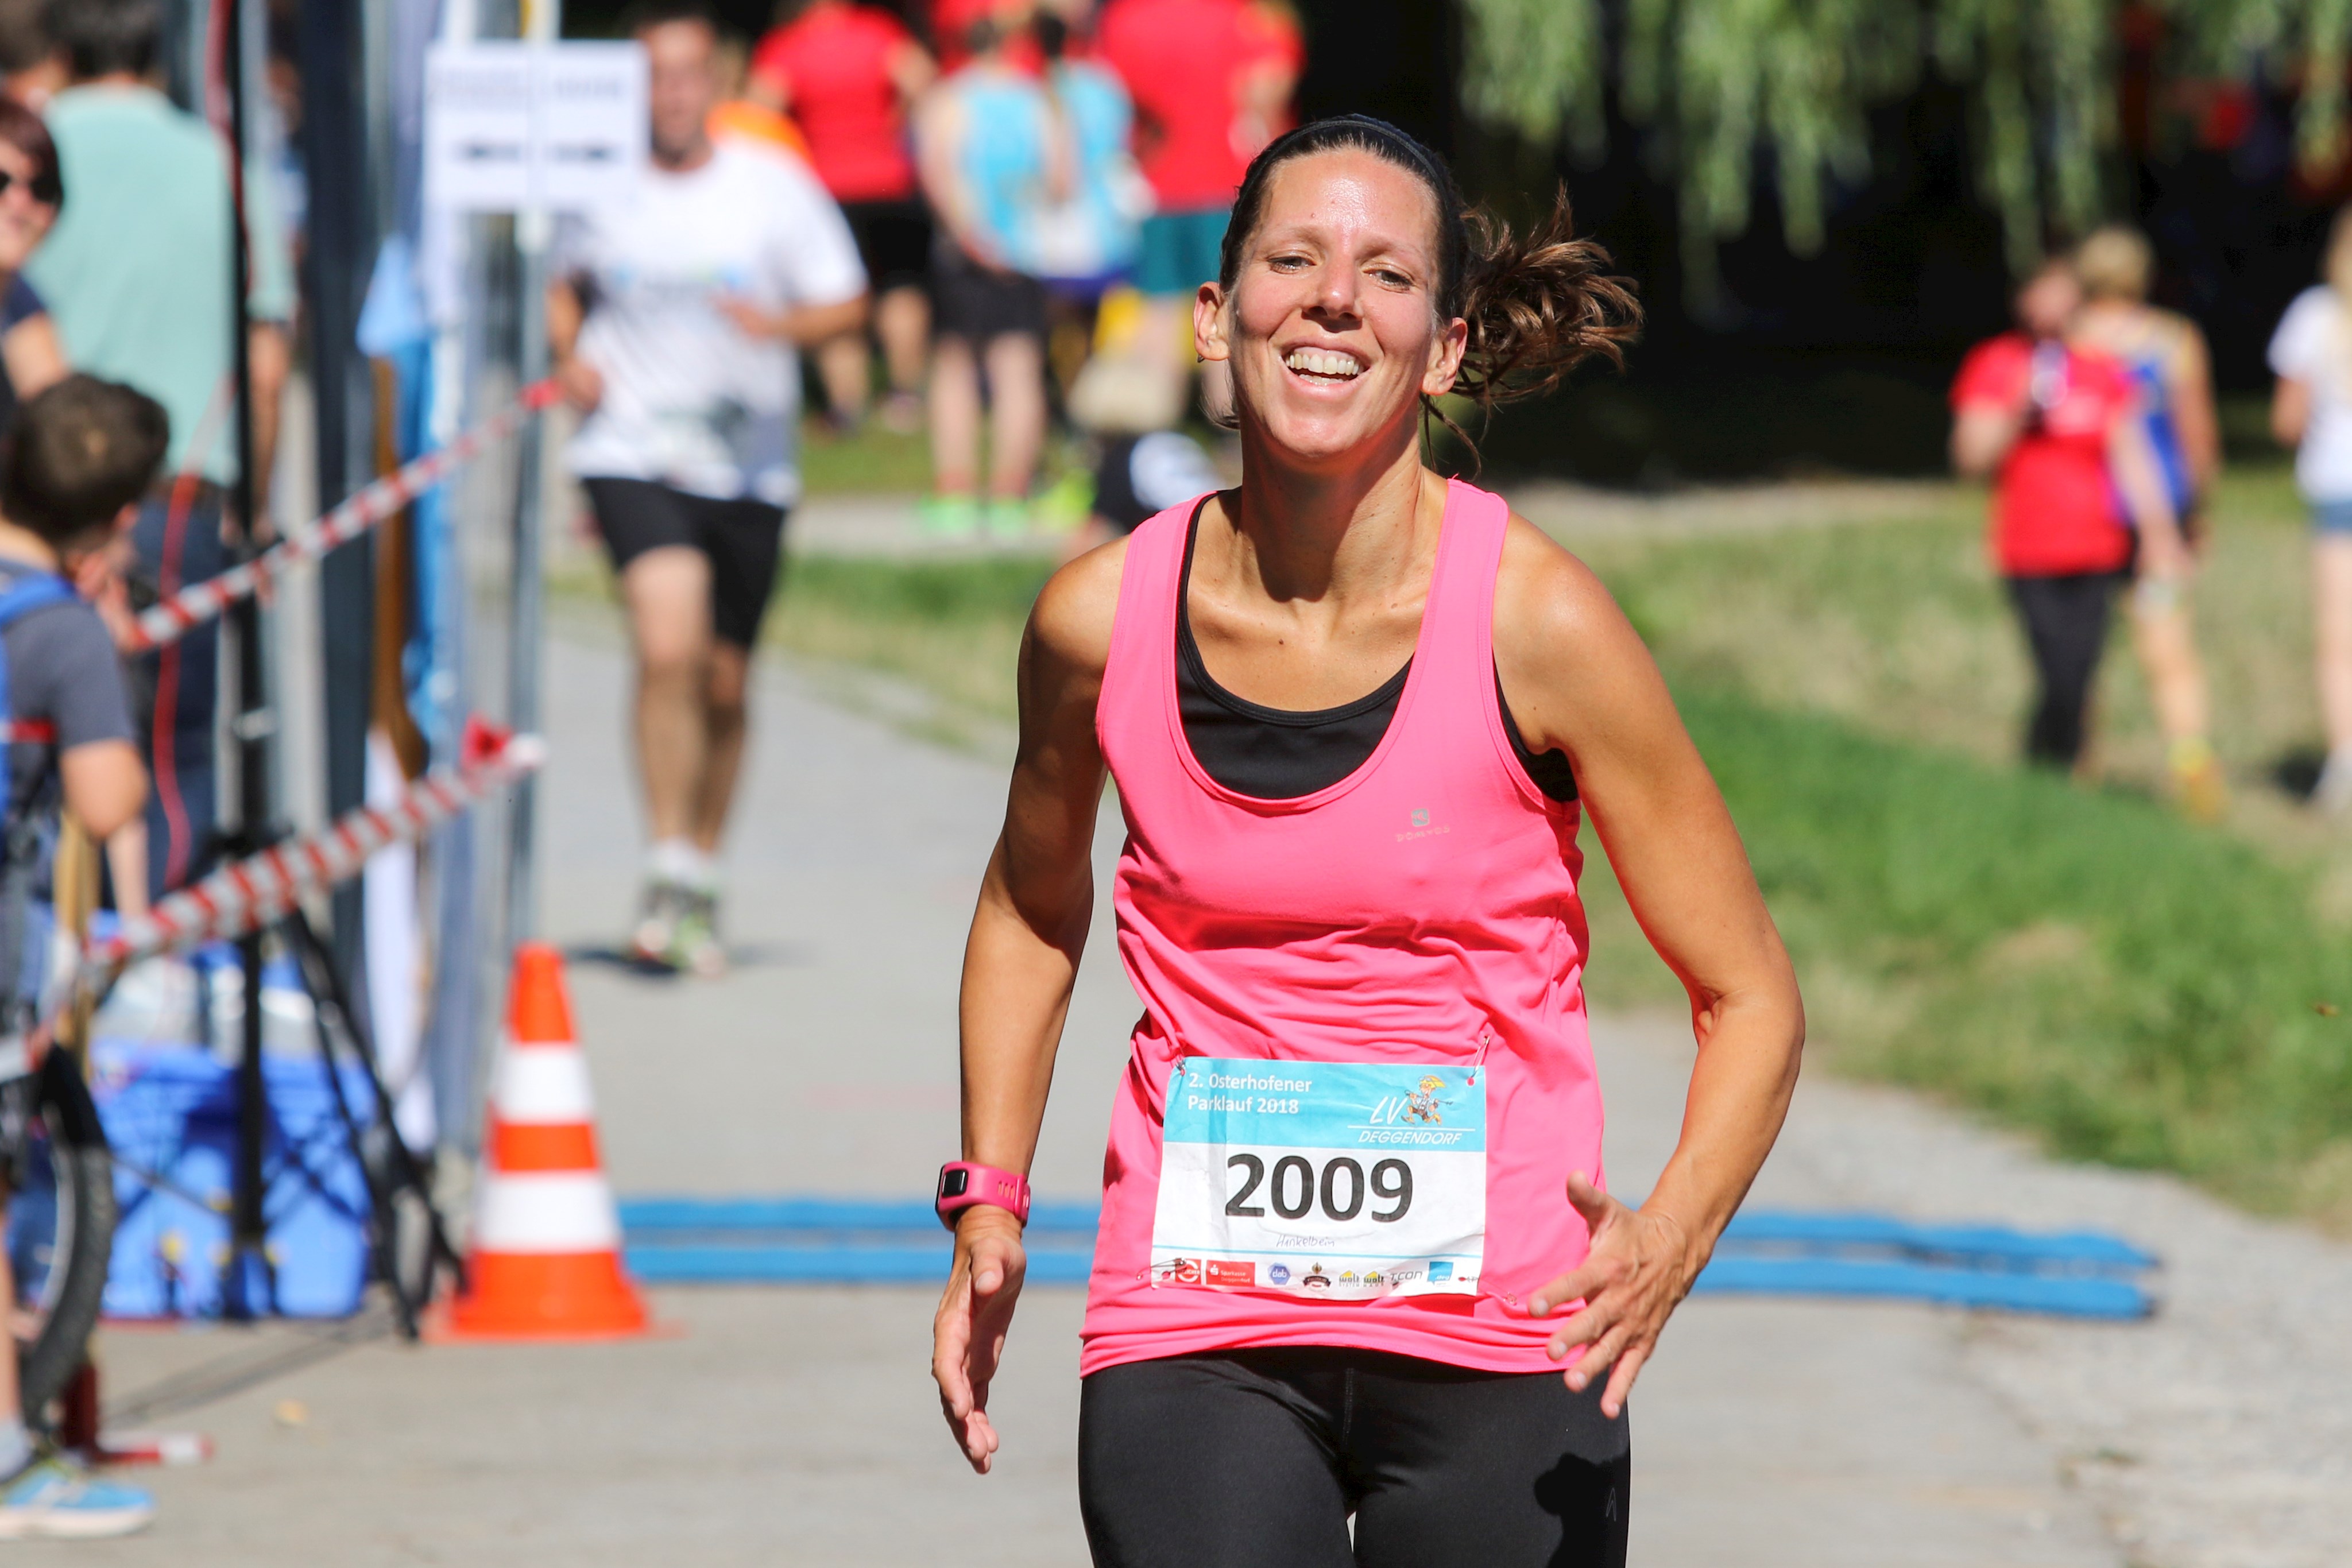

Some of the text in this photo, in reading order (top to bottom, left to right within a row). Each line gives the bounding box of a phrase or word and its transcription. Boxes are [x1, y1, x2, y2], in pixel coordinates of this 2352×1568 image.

[1189, 1073, 1312, 1092] 2. Osterhofener
[1188, 1095, 1299, 1114] Parklauf 2018
[1370, 1095, 1407, 1124] LV
[1358, 1130, 1463, 1145] DEGGENDORF
[1225, 1153, 1413, 1222] 2009
[1272, 1268, 1287, 1277] dab
